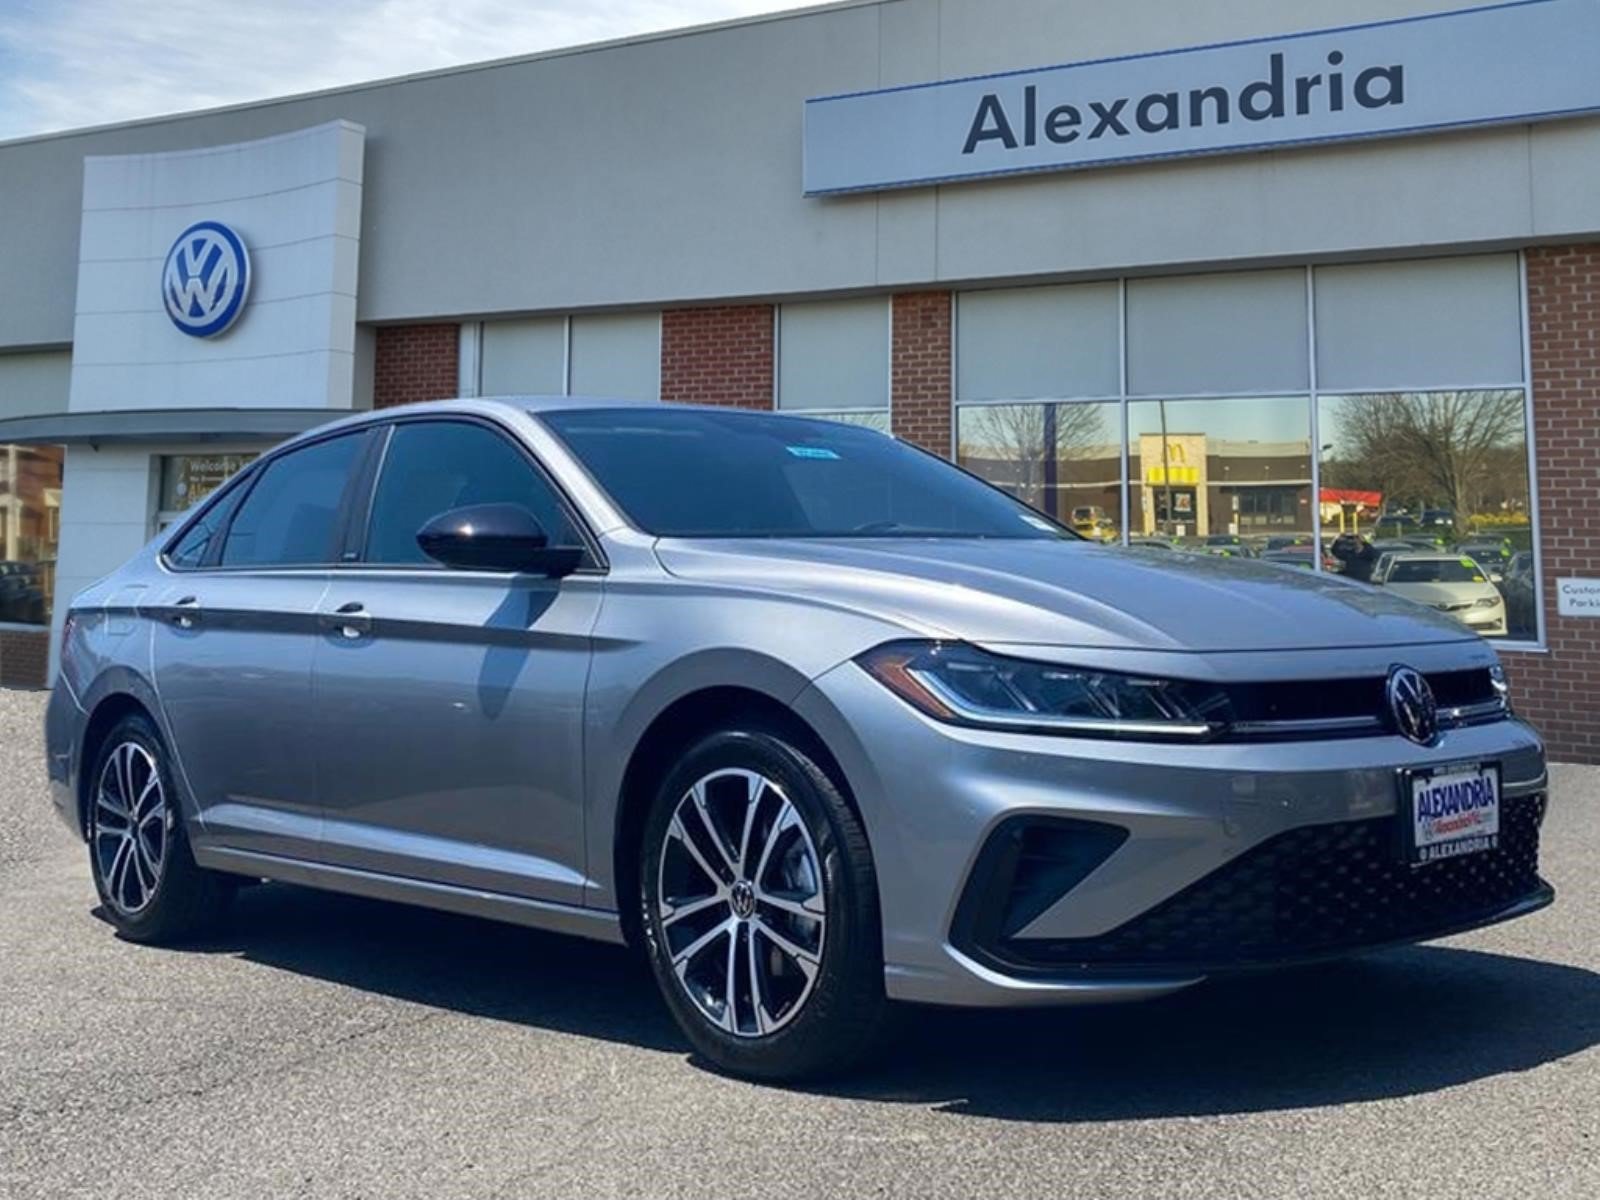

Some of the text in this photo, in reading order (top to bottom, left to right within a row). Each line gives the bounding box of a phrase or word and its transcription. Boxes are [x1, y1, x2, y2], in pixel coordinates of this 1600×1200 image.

[962, 50, 1404, 154] Alexandria
[165, 228, 239, 327] VW
[1562, 584, 1600, 594] Custo
[1418, 776, 1495, 822] ALEXANDRIA
[1429, 836, 1490, 859] ALEXANDRIA
